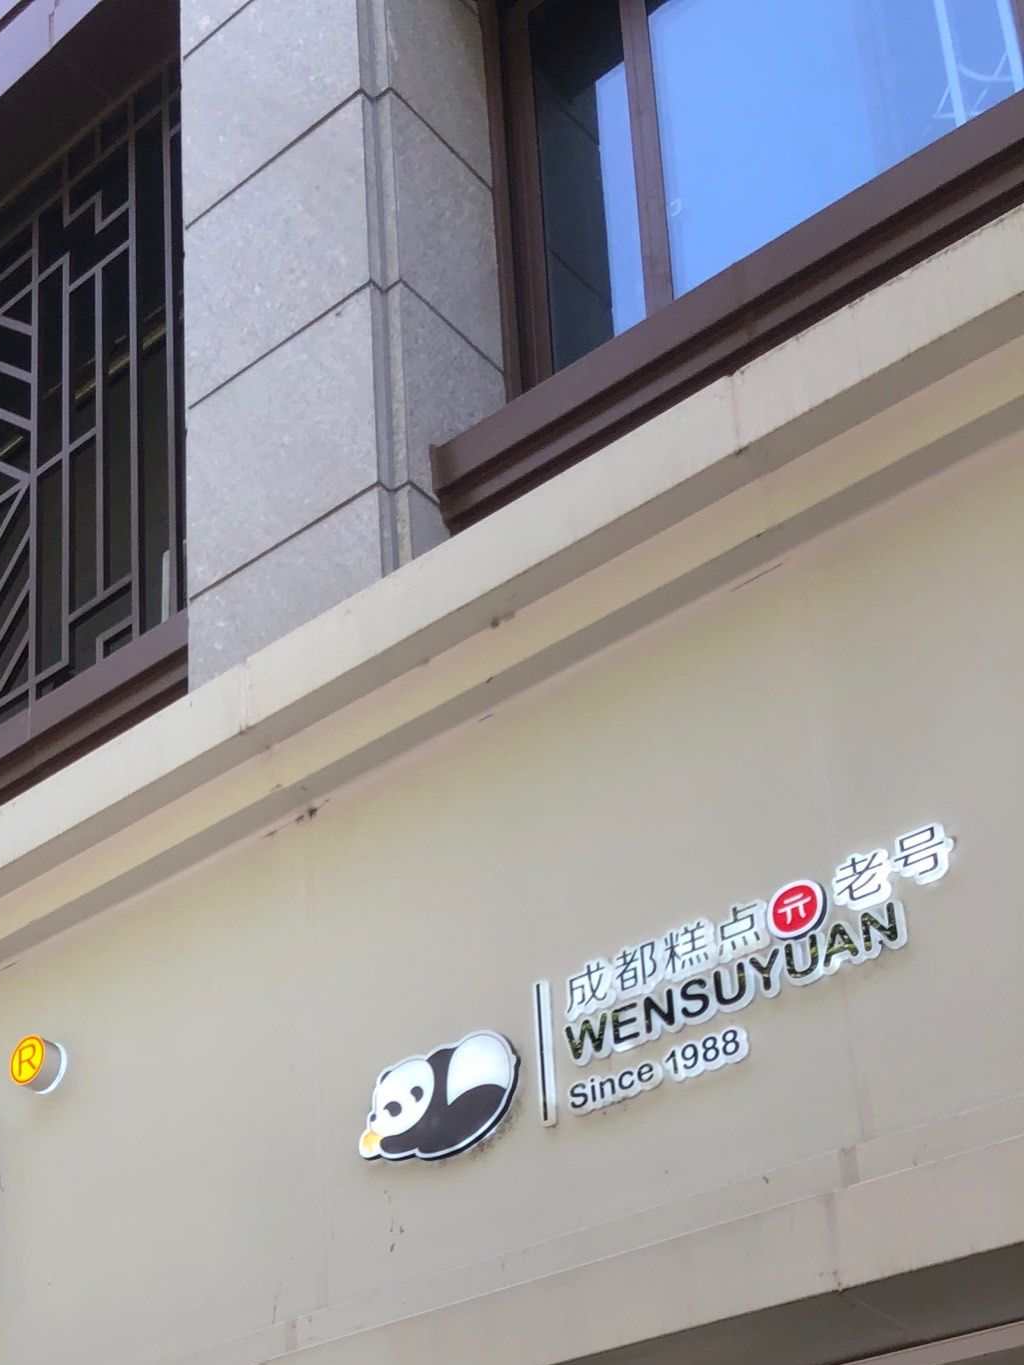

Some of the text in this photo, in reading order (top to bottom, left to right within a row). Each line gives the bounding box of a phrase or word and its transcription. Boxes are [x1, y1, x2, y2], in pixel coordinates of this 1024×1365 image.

[564, 901, 902, 1062] WENSUYUAN
[570, 1029, 742, 1110] Since 1988
